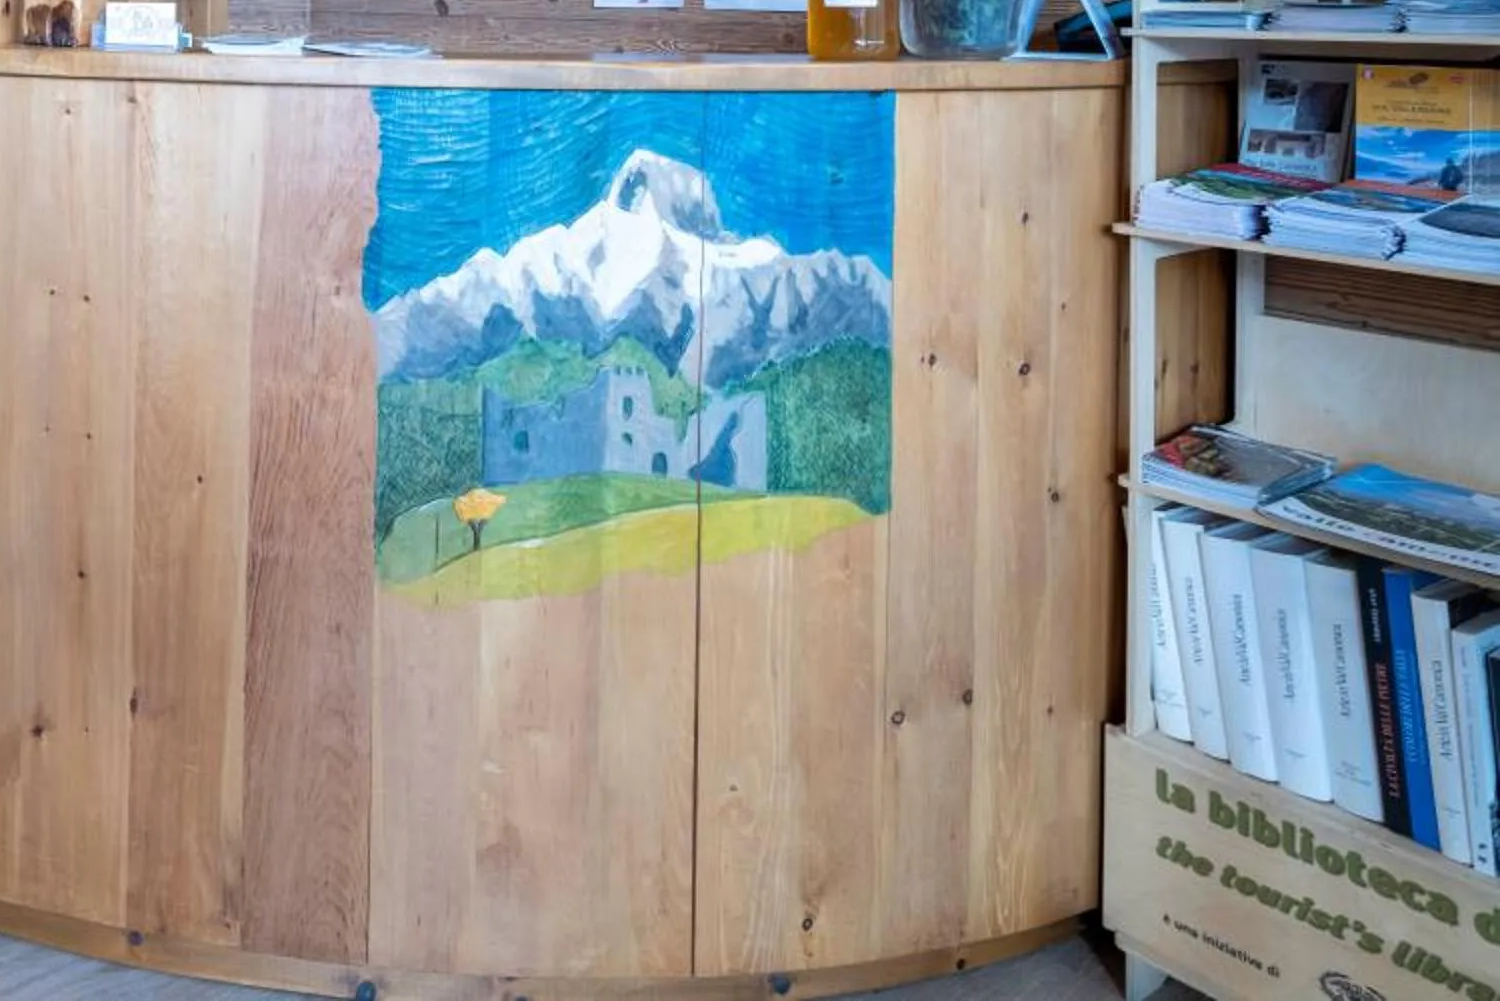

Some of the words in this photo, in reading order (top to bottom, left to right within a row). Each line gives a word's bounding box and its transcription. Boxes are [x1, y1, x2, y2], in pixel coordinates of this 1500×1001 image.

[1155, 768, 1195, 814] la
[1208, 790, 1459, 926] biblioteca
[1155, 835, 1214, 877] the
[1219, 864, 1385, 954] tourist's
[1174, 920, 1198, 939] una
[1202, 932, 1263, 971] iniziativa
[1267, 964, 1280, 979] di
